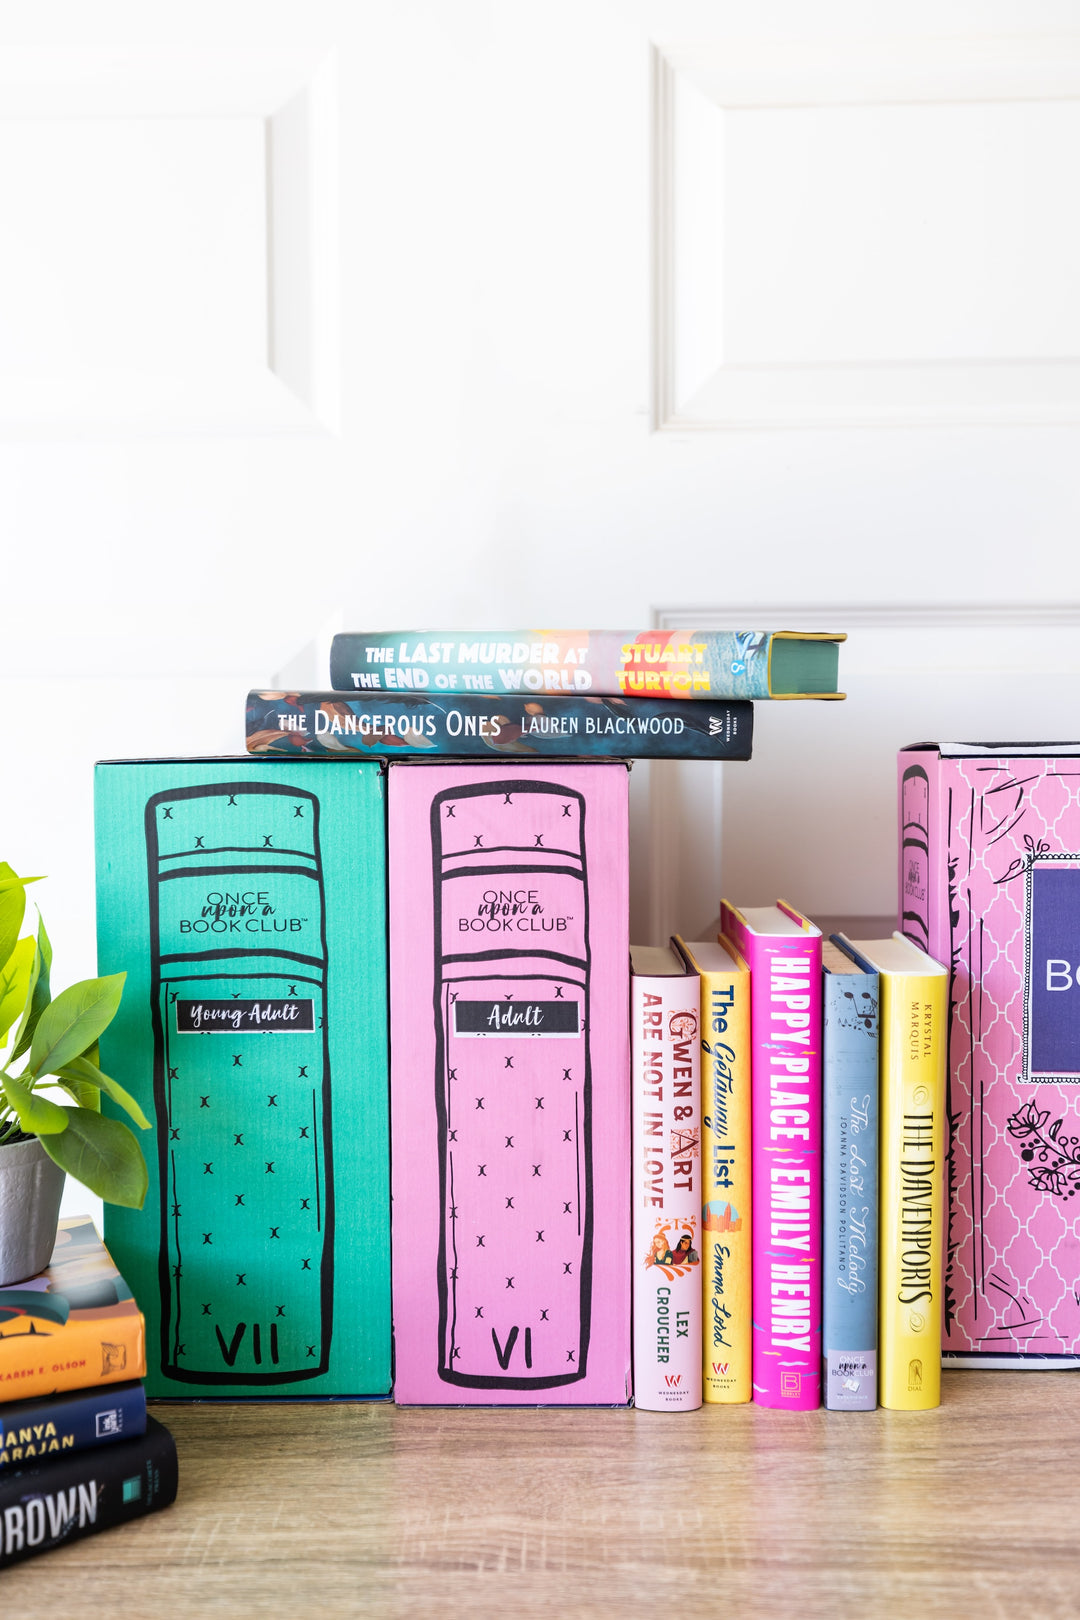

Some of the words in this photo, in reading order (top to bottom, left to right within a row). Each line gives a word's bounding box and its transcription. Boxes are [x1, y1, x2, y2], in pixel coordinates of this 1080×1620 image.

[365, 647, 394, 663] THE
[398, 642, 454, 664] LAST
[458, 642, 562, 665] MURDER
[563, 647, 588, 665] AT
[620, 643, 708, 664] STUART
[351, 672, 381, 688] THE
[384, 667, 430, 689] END
[434, 674, 458, 689] OF
[462, 674, 494, 690] THE
[498, 668, 593, 691] WORLD
[615, 670, 711, 691] TURTON
[277, 714, 308, 731] THE
[314, 709, 437, 736] DANGEROUS
[446, 710, 501, 737] ONES
[521, 716, 578, 734] LAUREN
[585, 717, 684, 734] BLACKWOOD
[708, 715, 723, 736] W
[201, 904, 258, 921] upon
[261, 905, 276, 916] a
[206, 891, 270, 905] ONCE
[478, 902, 528, 920] upon
[531, 903, 544, 915] a
[482, 890, 539, 903] ONCE
[180, 920, 242, 933] BOOK
[458, 918, 513, 931] BOOK
[190, 1004, 247, 1028] Young
[248, 1003, 300, 1024] Adult
[486, 1004, 544, 1030] Adult
[642, 991, 663, 1040] ARE
[711, 984, 734, 1034] The
[770, 956, 811, 1046] HAPPY
[910, 1001, 919, 1061] MARQUIS
[923, 1003, 932, 1058] KRYSTAL
[668, 1009, 698, 1097] GWEN
[642, 1050, 663, 1101] NOT
[701, 1039, 736, 1139] Getaway
[674, 1104, 693, 1121] &
[769, 1055, 811, 1141] PLACE
[850, 1094, 870, 1136] The
[643, 1111, 663, 1137] IN
[903, 1111, 935, 1152] THE
[643, 1144, 664, 1209] LOVE
[670, 1128, 699, 1192] ART
[713, 1145, 736, 1189] List
[850, 1144, 867, 1197] Lost
[770, 1168, 811, 1252] EMILY
[839, 1163, 847, 1214] DAVIDSON
[837, 1206, 869, 1295] Melody
[838, 1220, 846, 1271] POLITANO
[898, 1160, 935, 1304] DAVENPORTS
[711, 1243, 730, 1297] Emma
[656, 1287, 671, 1364] CROUCHER
[676, 1310, 690, 1338] LEX
[712, 1297, 732, 1348] Lord
[770, 1262, 811, 1352] HENRY
[215, 1322, 279, 1367] VII
[491, 1325, 533, 1370] VI
[664, 1375, 682, 1388] W
[712, 1362, 730, 1375] W
[832, 1369, 854, 1377] BOOK
[0, 1479, 98, 1556] ROWN
